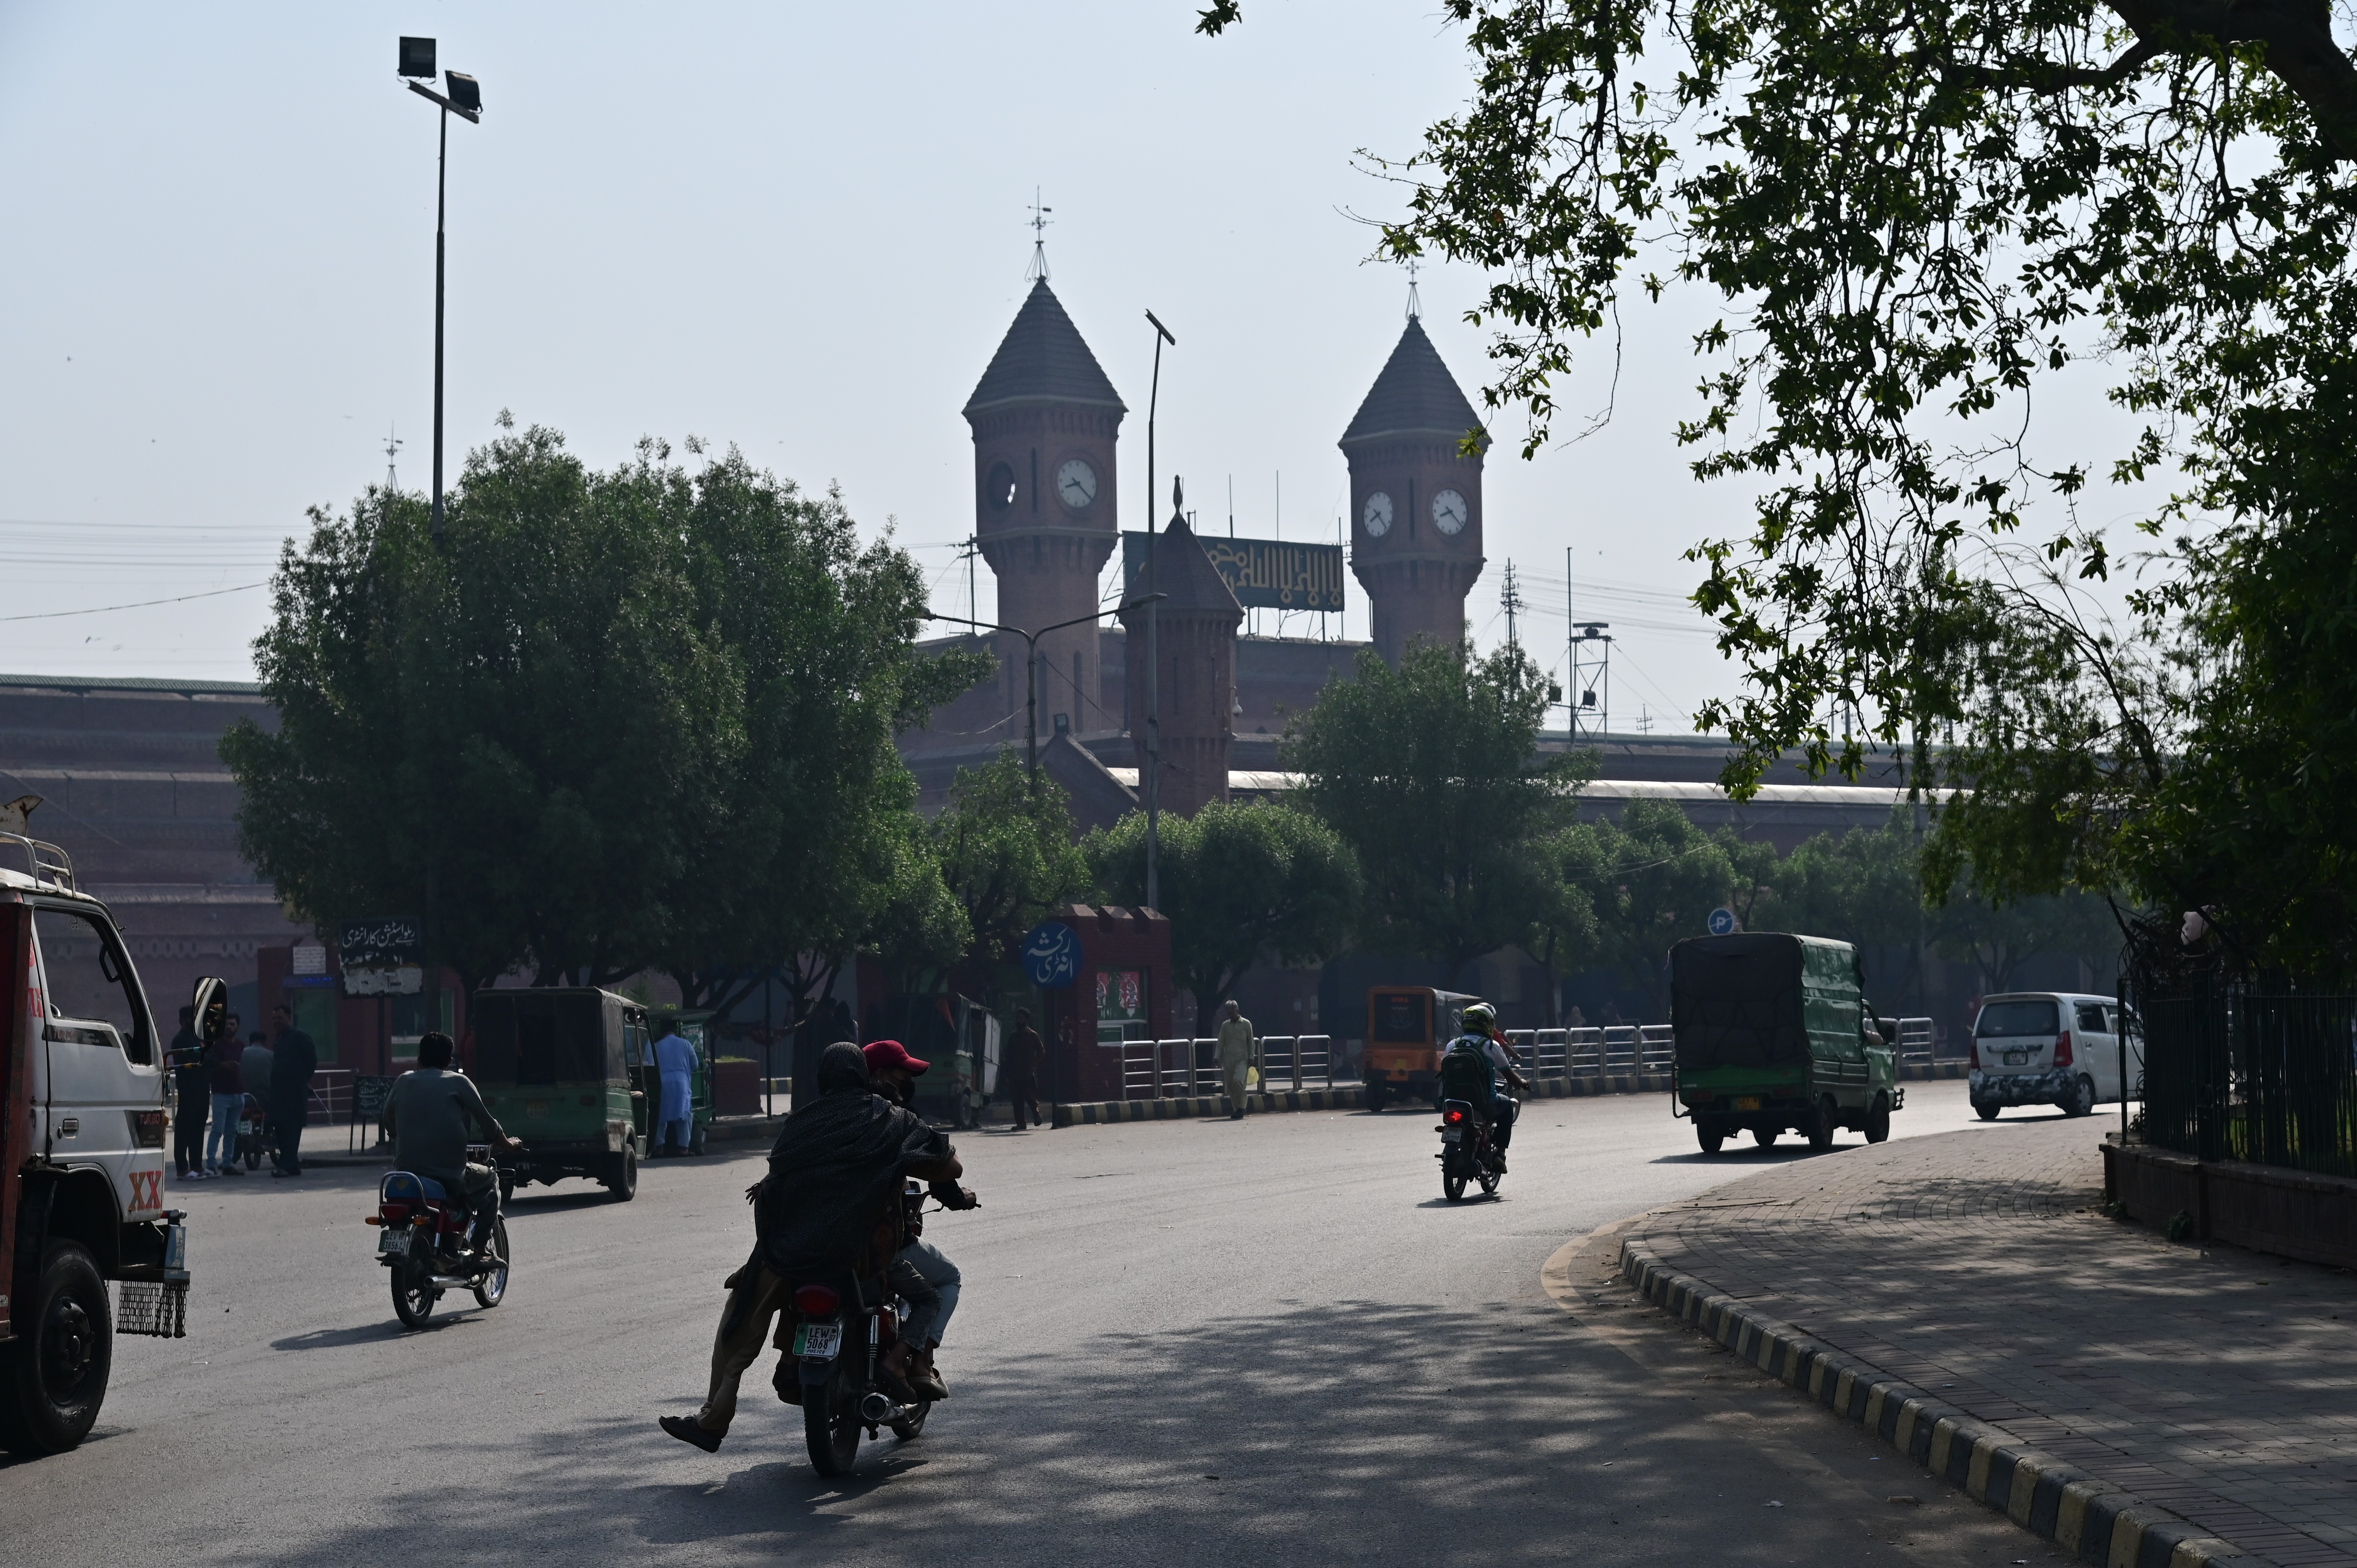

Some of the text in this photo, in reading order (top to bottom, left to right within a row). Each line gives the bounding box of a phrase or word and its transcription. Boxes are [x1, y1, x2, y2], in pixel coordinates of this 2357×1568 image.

[1716, 916, 1726, 930] P
[1036, 953, 1073, 983] انٹری
[140, 1113, 160, 1125] TURBO
[384, 1241, 398, 1250] 3856
[809, 1328, 830, 1338] LEW
[807, 1338, 829, 1350] 5068
